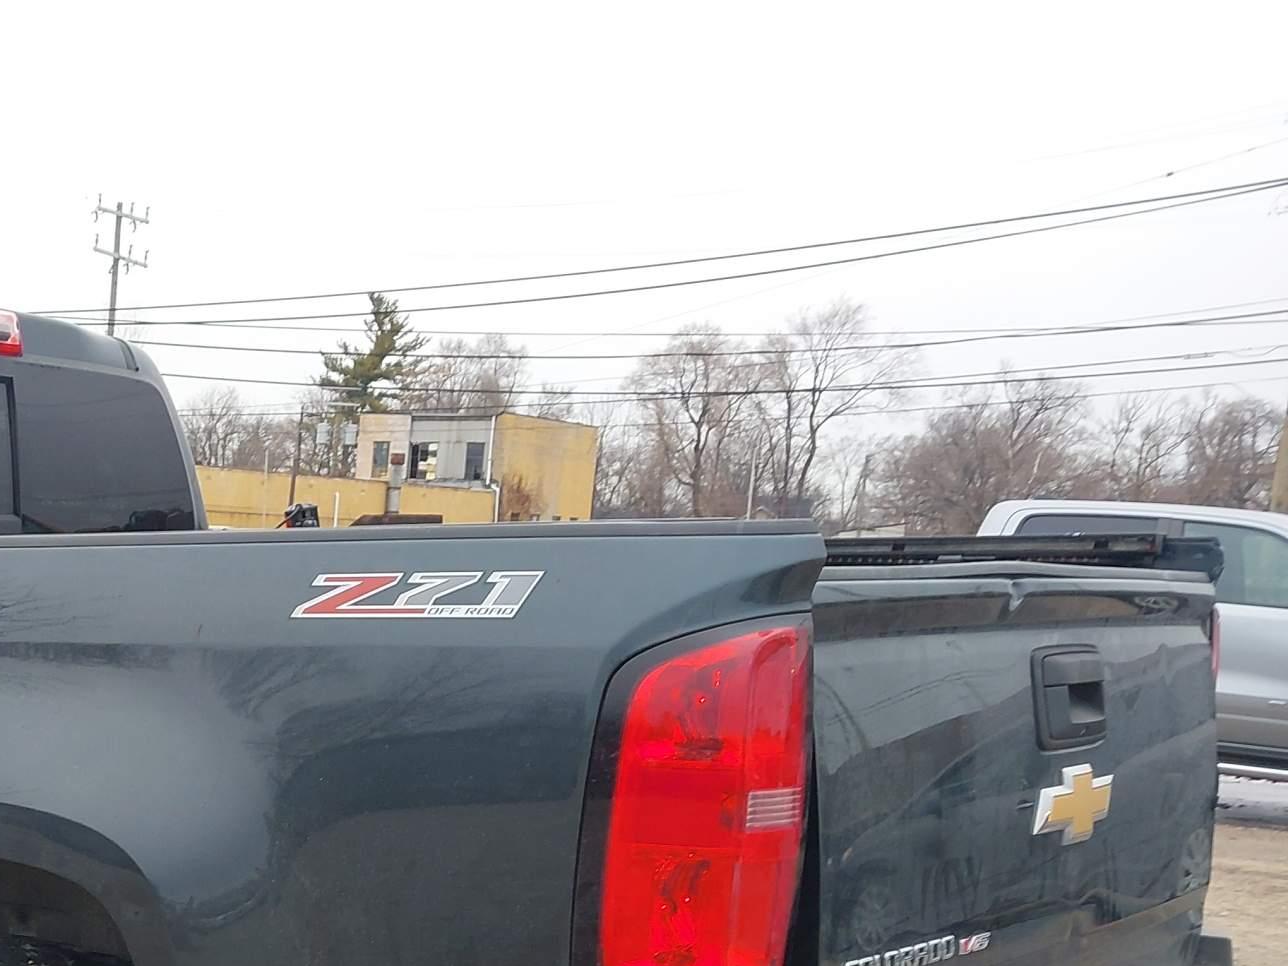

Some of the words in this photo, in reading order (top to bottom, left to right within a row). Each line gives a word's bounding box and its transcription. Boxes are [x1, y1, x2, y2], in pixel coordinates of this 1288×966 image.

[289, 570, 546, 618] Z71
[427, 607, 462, 616] OFF
[464, 607, 515, 616] ROAD
[958, 931, 992, 956] V6
